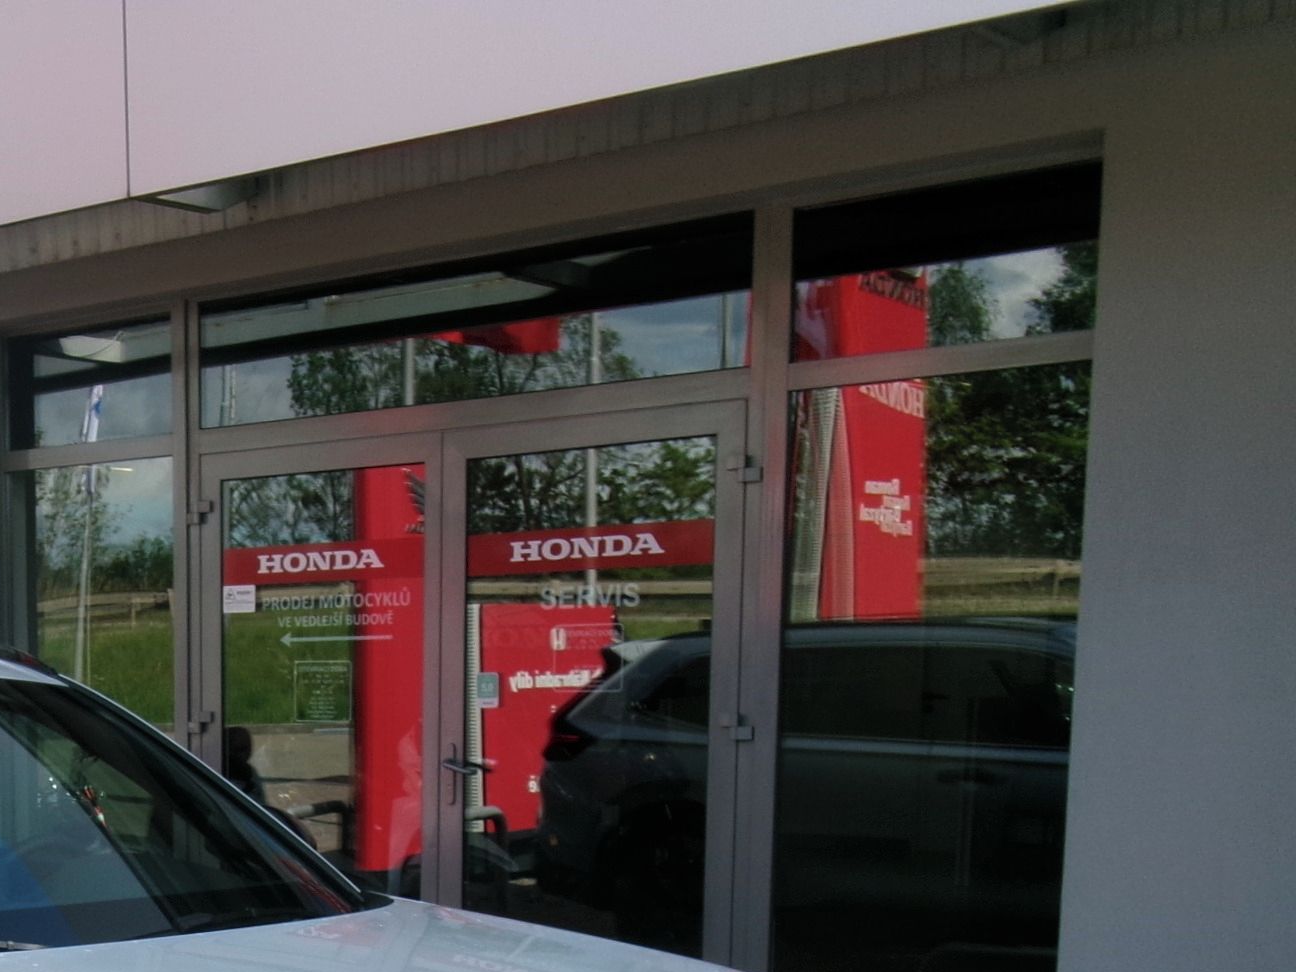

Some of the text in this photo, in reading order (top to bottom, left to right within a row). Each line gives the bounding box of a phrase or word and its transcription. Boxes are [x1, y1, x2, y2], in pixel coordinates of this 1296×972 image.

[510, 532, 666, 562] HONDA
[257, 548, 385, 574] HONDA
[261, 595, 316, 611] PRODEJ
[319, 587, 411, 609] MOTOCYKLŮ
[540, 582, 641, 610] SERVIS
[277, 617, 292, 628] VE
[345, 610, 394, 626] BUDOVĚ
